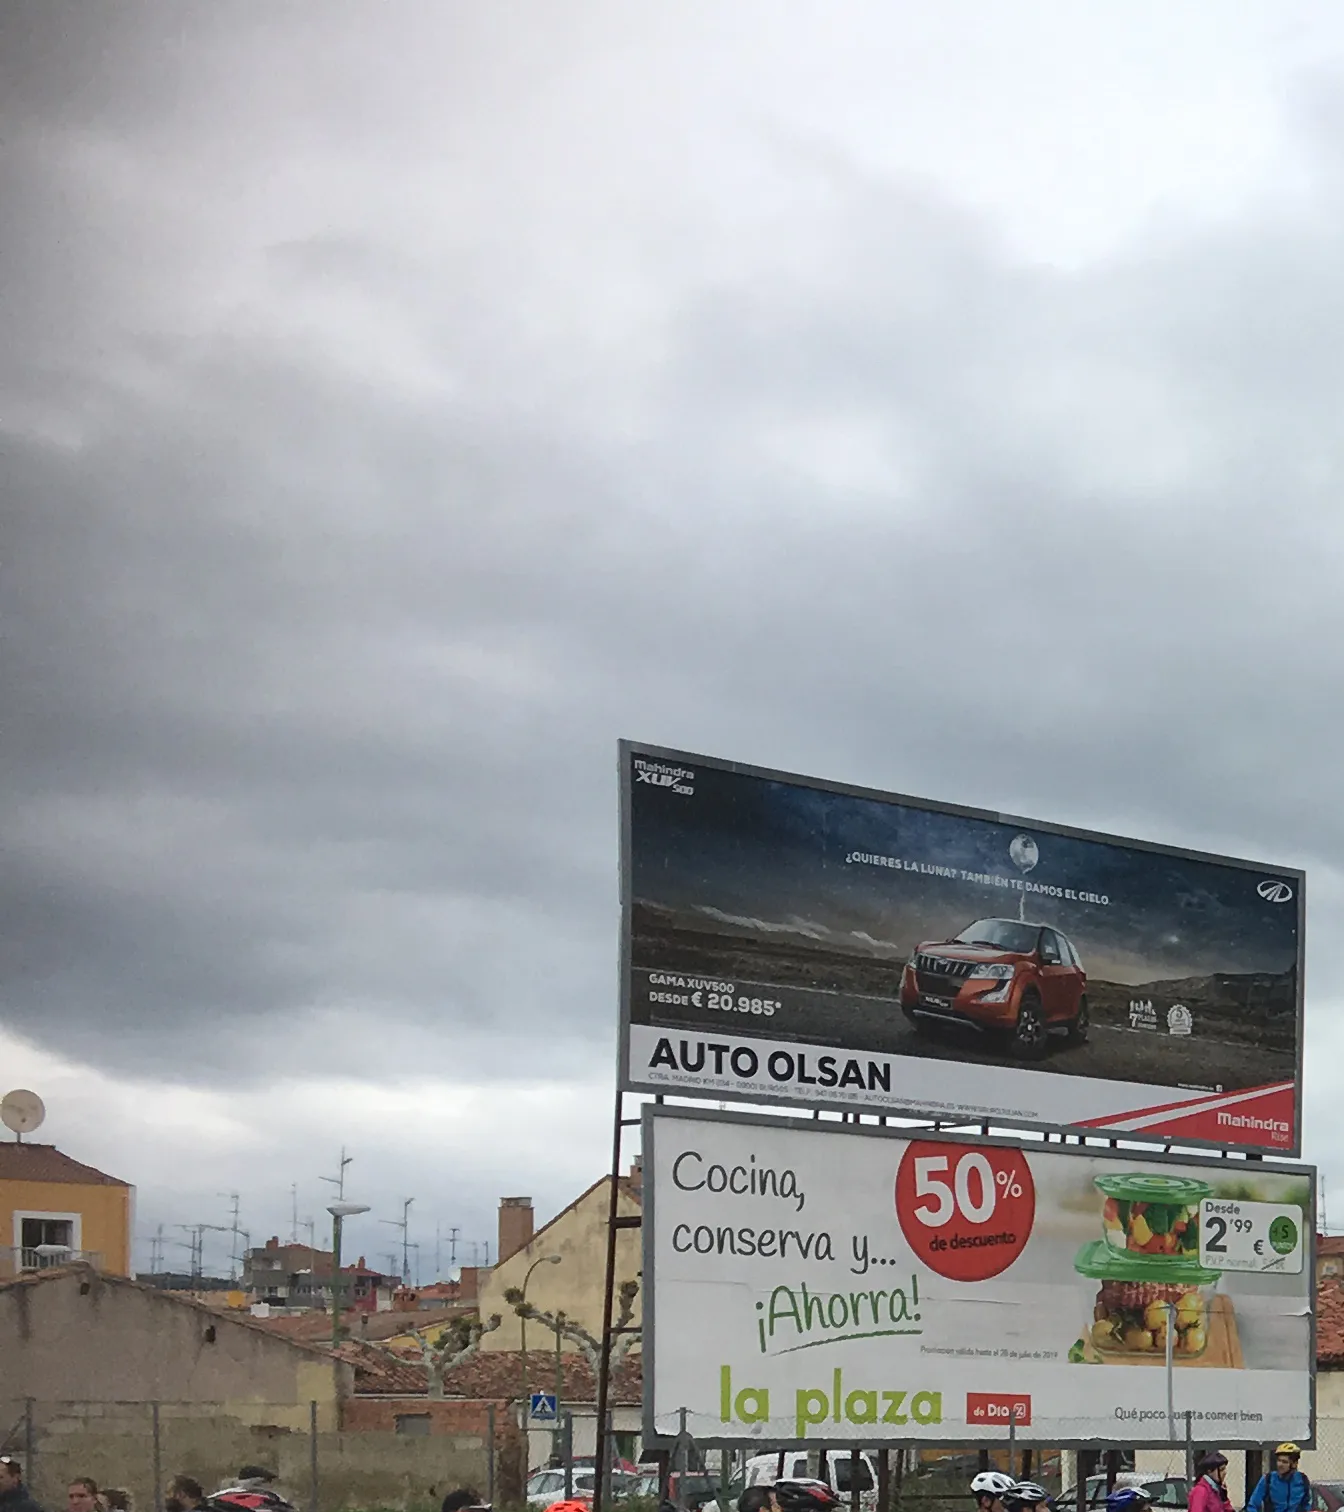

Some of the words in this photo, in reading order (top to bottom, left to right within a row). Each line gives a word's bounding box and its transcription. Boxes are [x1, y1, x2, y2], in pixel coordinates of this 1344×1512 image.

[634, 759, 694, 780] Mahindra
[845, 851, 901, 870] ¿QUIERES
[903, 860, 919, 873] LA
[920, 864, 957, 880] LUNA?
[960, 869, 1009, 889] TAMBIÉN
[1009, 879, 1024, 891] TE
[1025, 881, 1063, 899] DAMOS
[1064, 888, 1078, 901] EL
[649, 974, 686, 987] GAMA
[687, 978, 735, 994] XUV500
[649, 991, 688, 1006] DESDE
[691, 991, 703, 1008] €
[648, 1037, 759, 1078] AUTO
[767, 1050, 891, 1093] OLSAN
[1217, 1111, 1289, 1132] Mahindra
[672, 1150, 805, 1212] Cocina,
[913, 1152, 1022, 1228] 50%
[1205, 1202, 1241, 1215] Desde
[672, 1223, 835, 1261] conserva
[850, 1234, 896, 1275] y...
[929, 1234, 948, 1252] de
[950, 1231, 1017, 1250] descuento
[1253, 1239, 1264, 1256] €
[754, 1273, 923, 1353] ¡Ahorra!
[720, 1365, 769, 1424] la
[796, 1367, 943, 1440] plaza
[973, 1406, 985, 1418] de
[1114, 1406, 1137, 1421] Qué
[1139, 1409, 1167, 1423] poco
[1205, 1410, 1238, 1421] comer
[1240, 1409, 1263, 1422] bien
